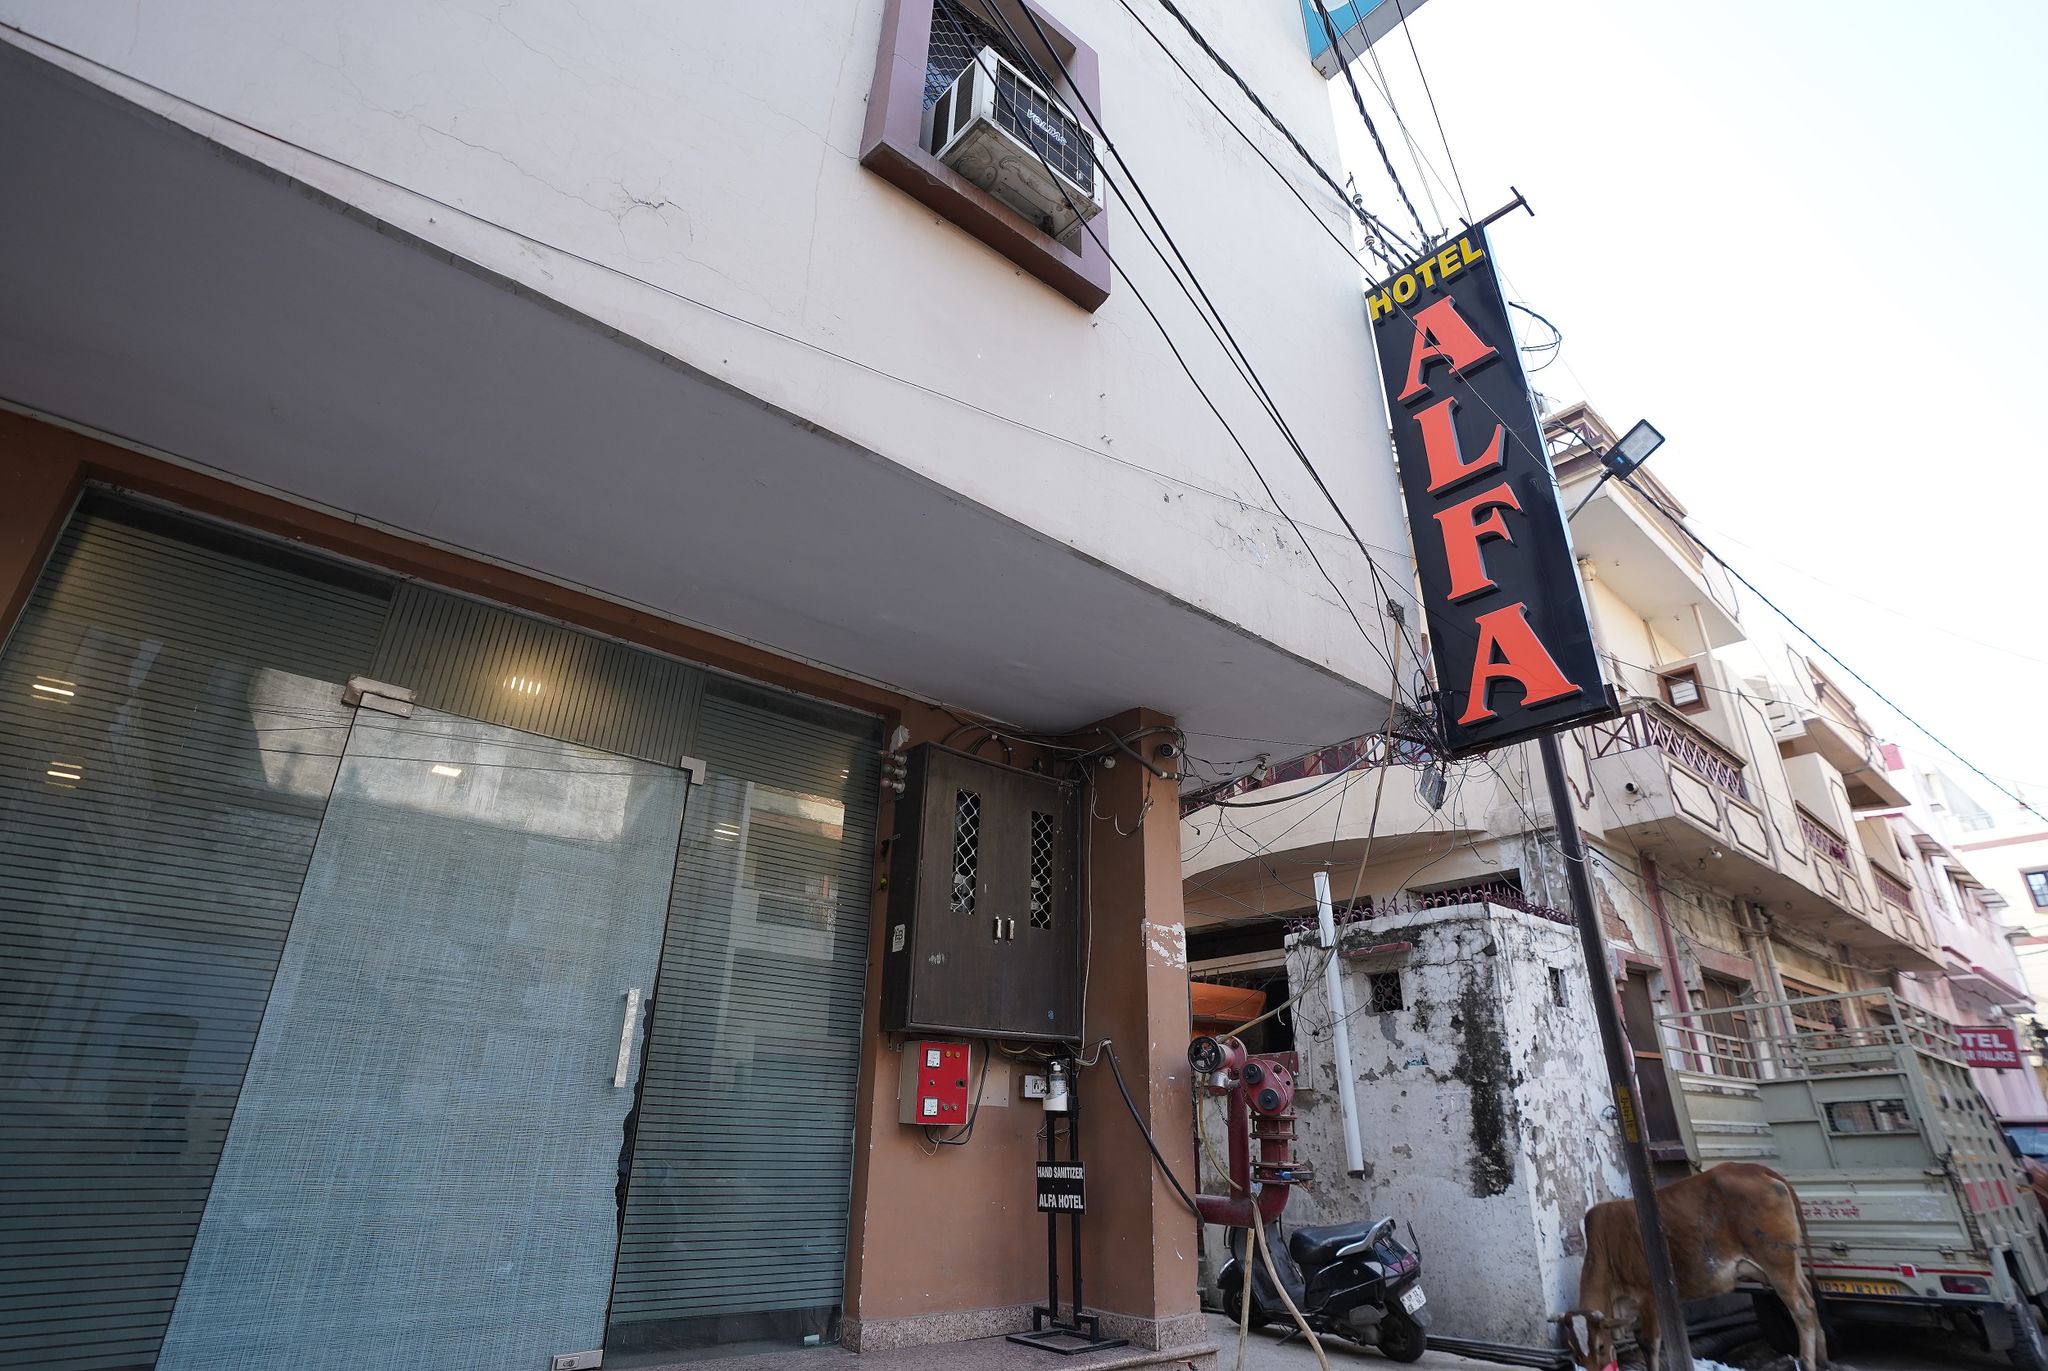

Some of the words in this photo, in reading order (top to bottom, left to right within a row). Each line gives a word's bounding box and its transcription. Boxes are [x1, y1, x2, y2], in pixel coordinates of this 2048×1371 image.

[1026, 108, 1068, 146] VOLTAS
[1367, 236, 1484, 322] HOTEL
[1397, 294, 1584, 727] ALFA
[1037, 1166, 1053, 1178] HAND
[1053, 1166, 1083, 1179] SANITIZER
[1038, 1193, 1057, 1208] ALFA
[1058, 1194, 1083, 1209] HOTEL
